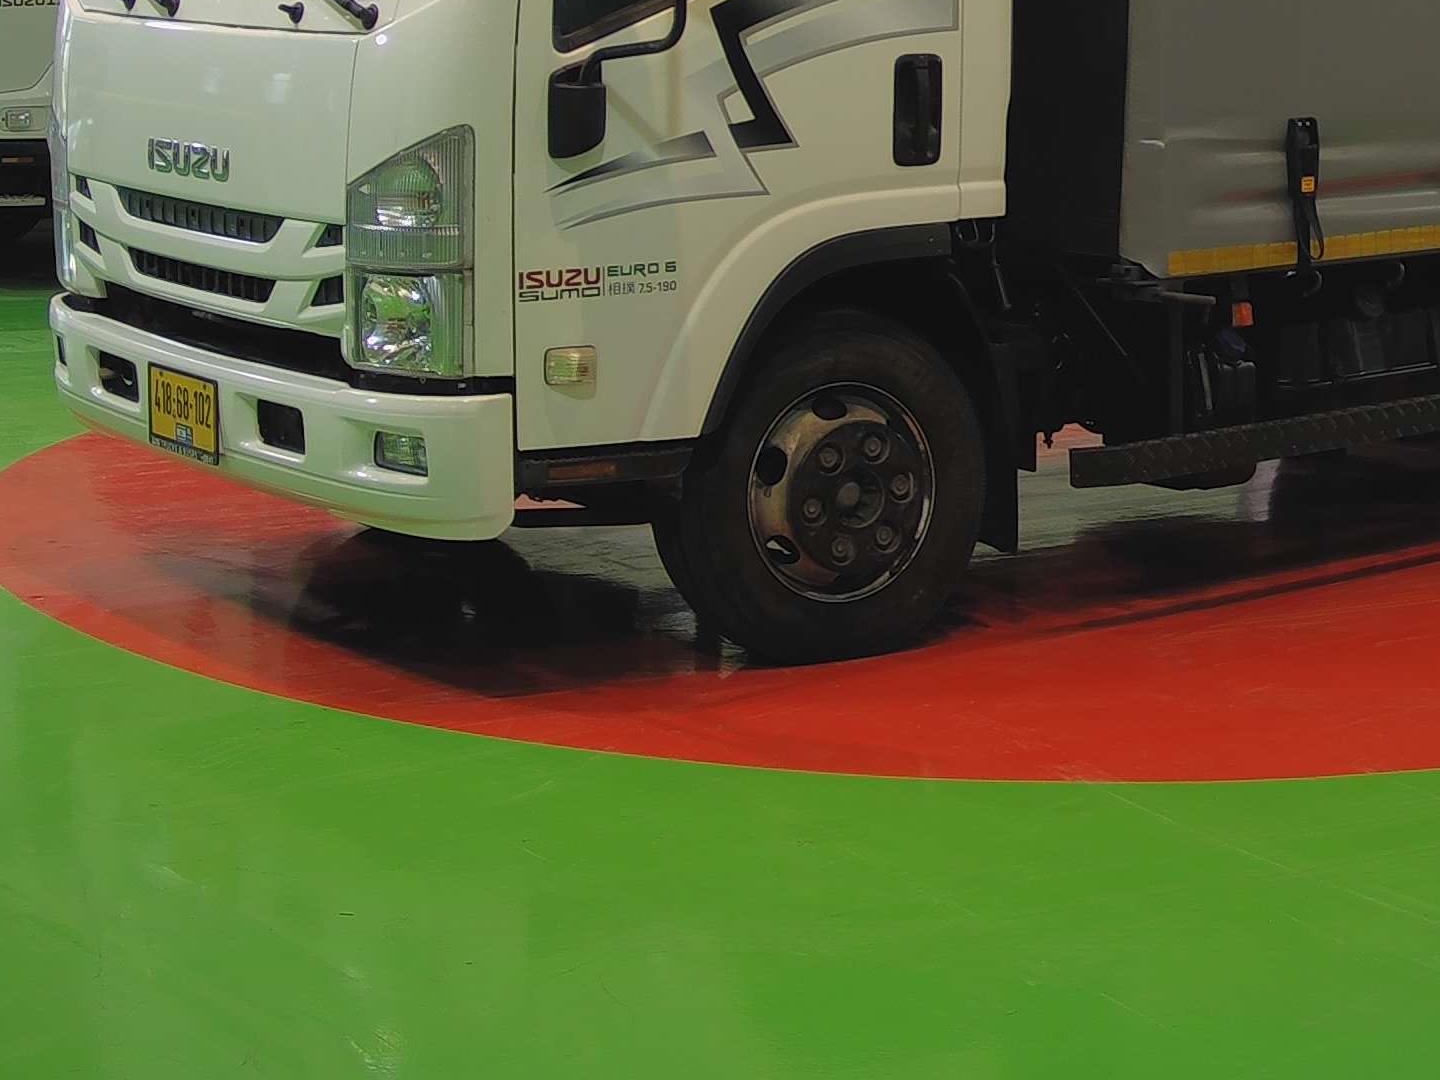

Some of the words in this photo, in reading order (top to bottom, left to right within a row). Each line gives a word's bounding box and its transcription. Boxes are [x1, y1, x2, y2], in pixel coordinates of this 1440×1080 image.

[147, 137, 230, 182] ISUZU
[518, 267, 601, 291] ISUZU
[607, 262, 659, 278] EURO
[665, 261, 677, 273] 6
